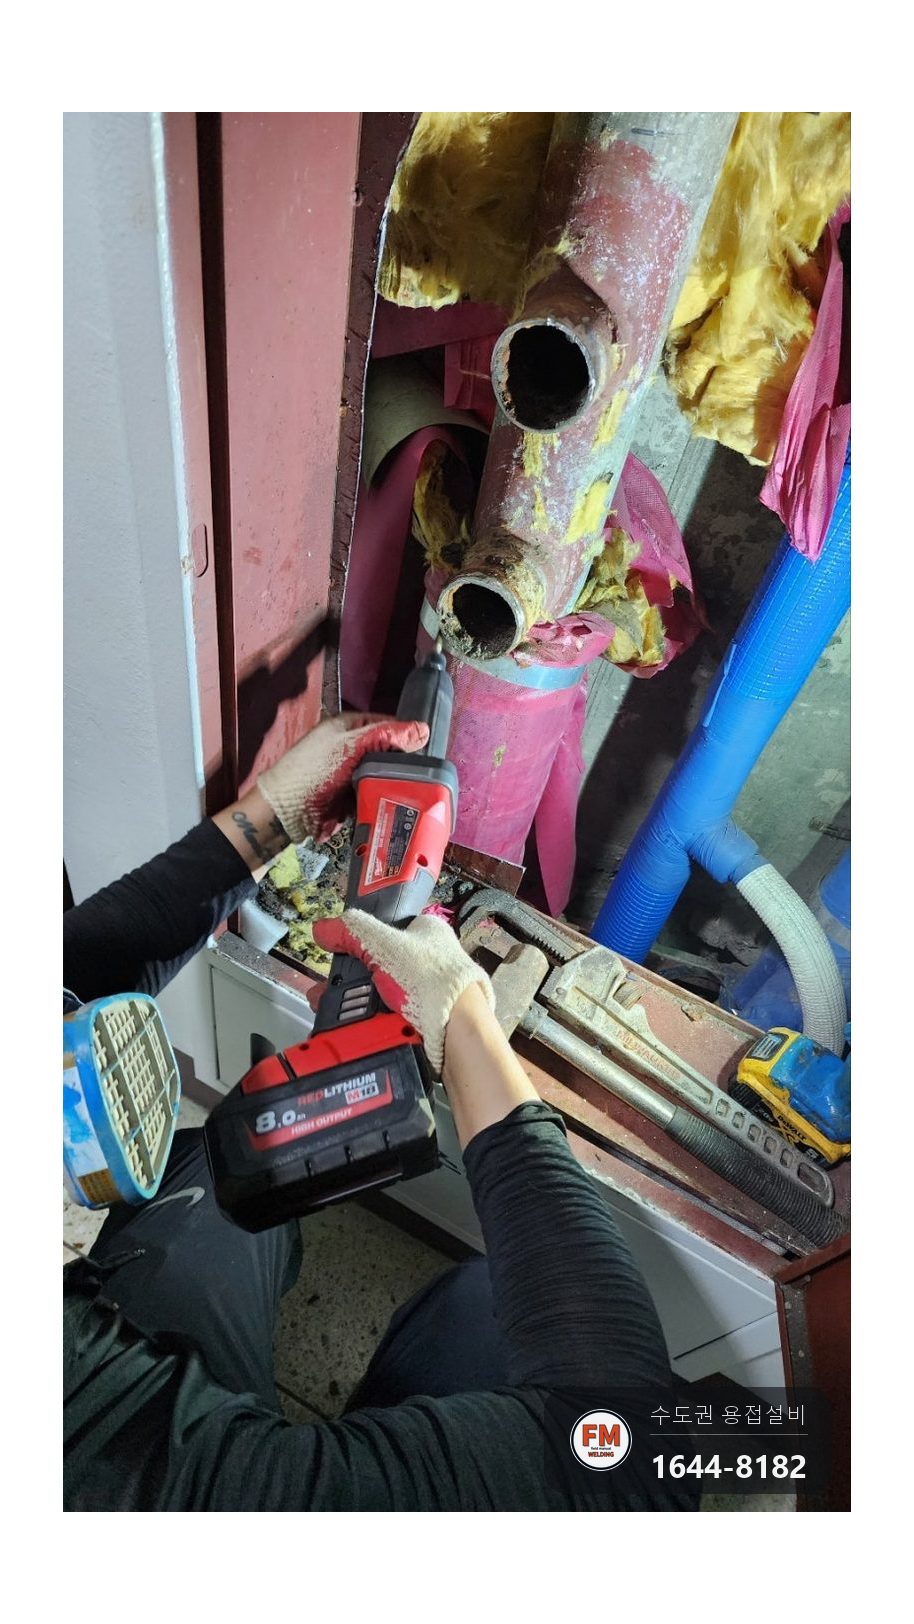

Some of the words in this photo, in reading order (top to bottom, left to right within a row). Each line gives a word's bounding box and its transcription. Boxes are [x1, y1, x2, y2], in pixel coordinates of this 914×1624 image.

[297, 1072, 376, 1106] REDLITHIUM
[291, 1120, 315, 1136] HIGH
[315, 1108, 353, 1127] OUTPUT
